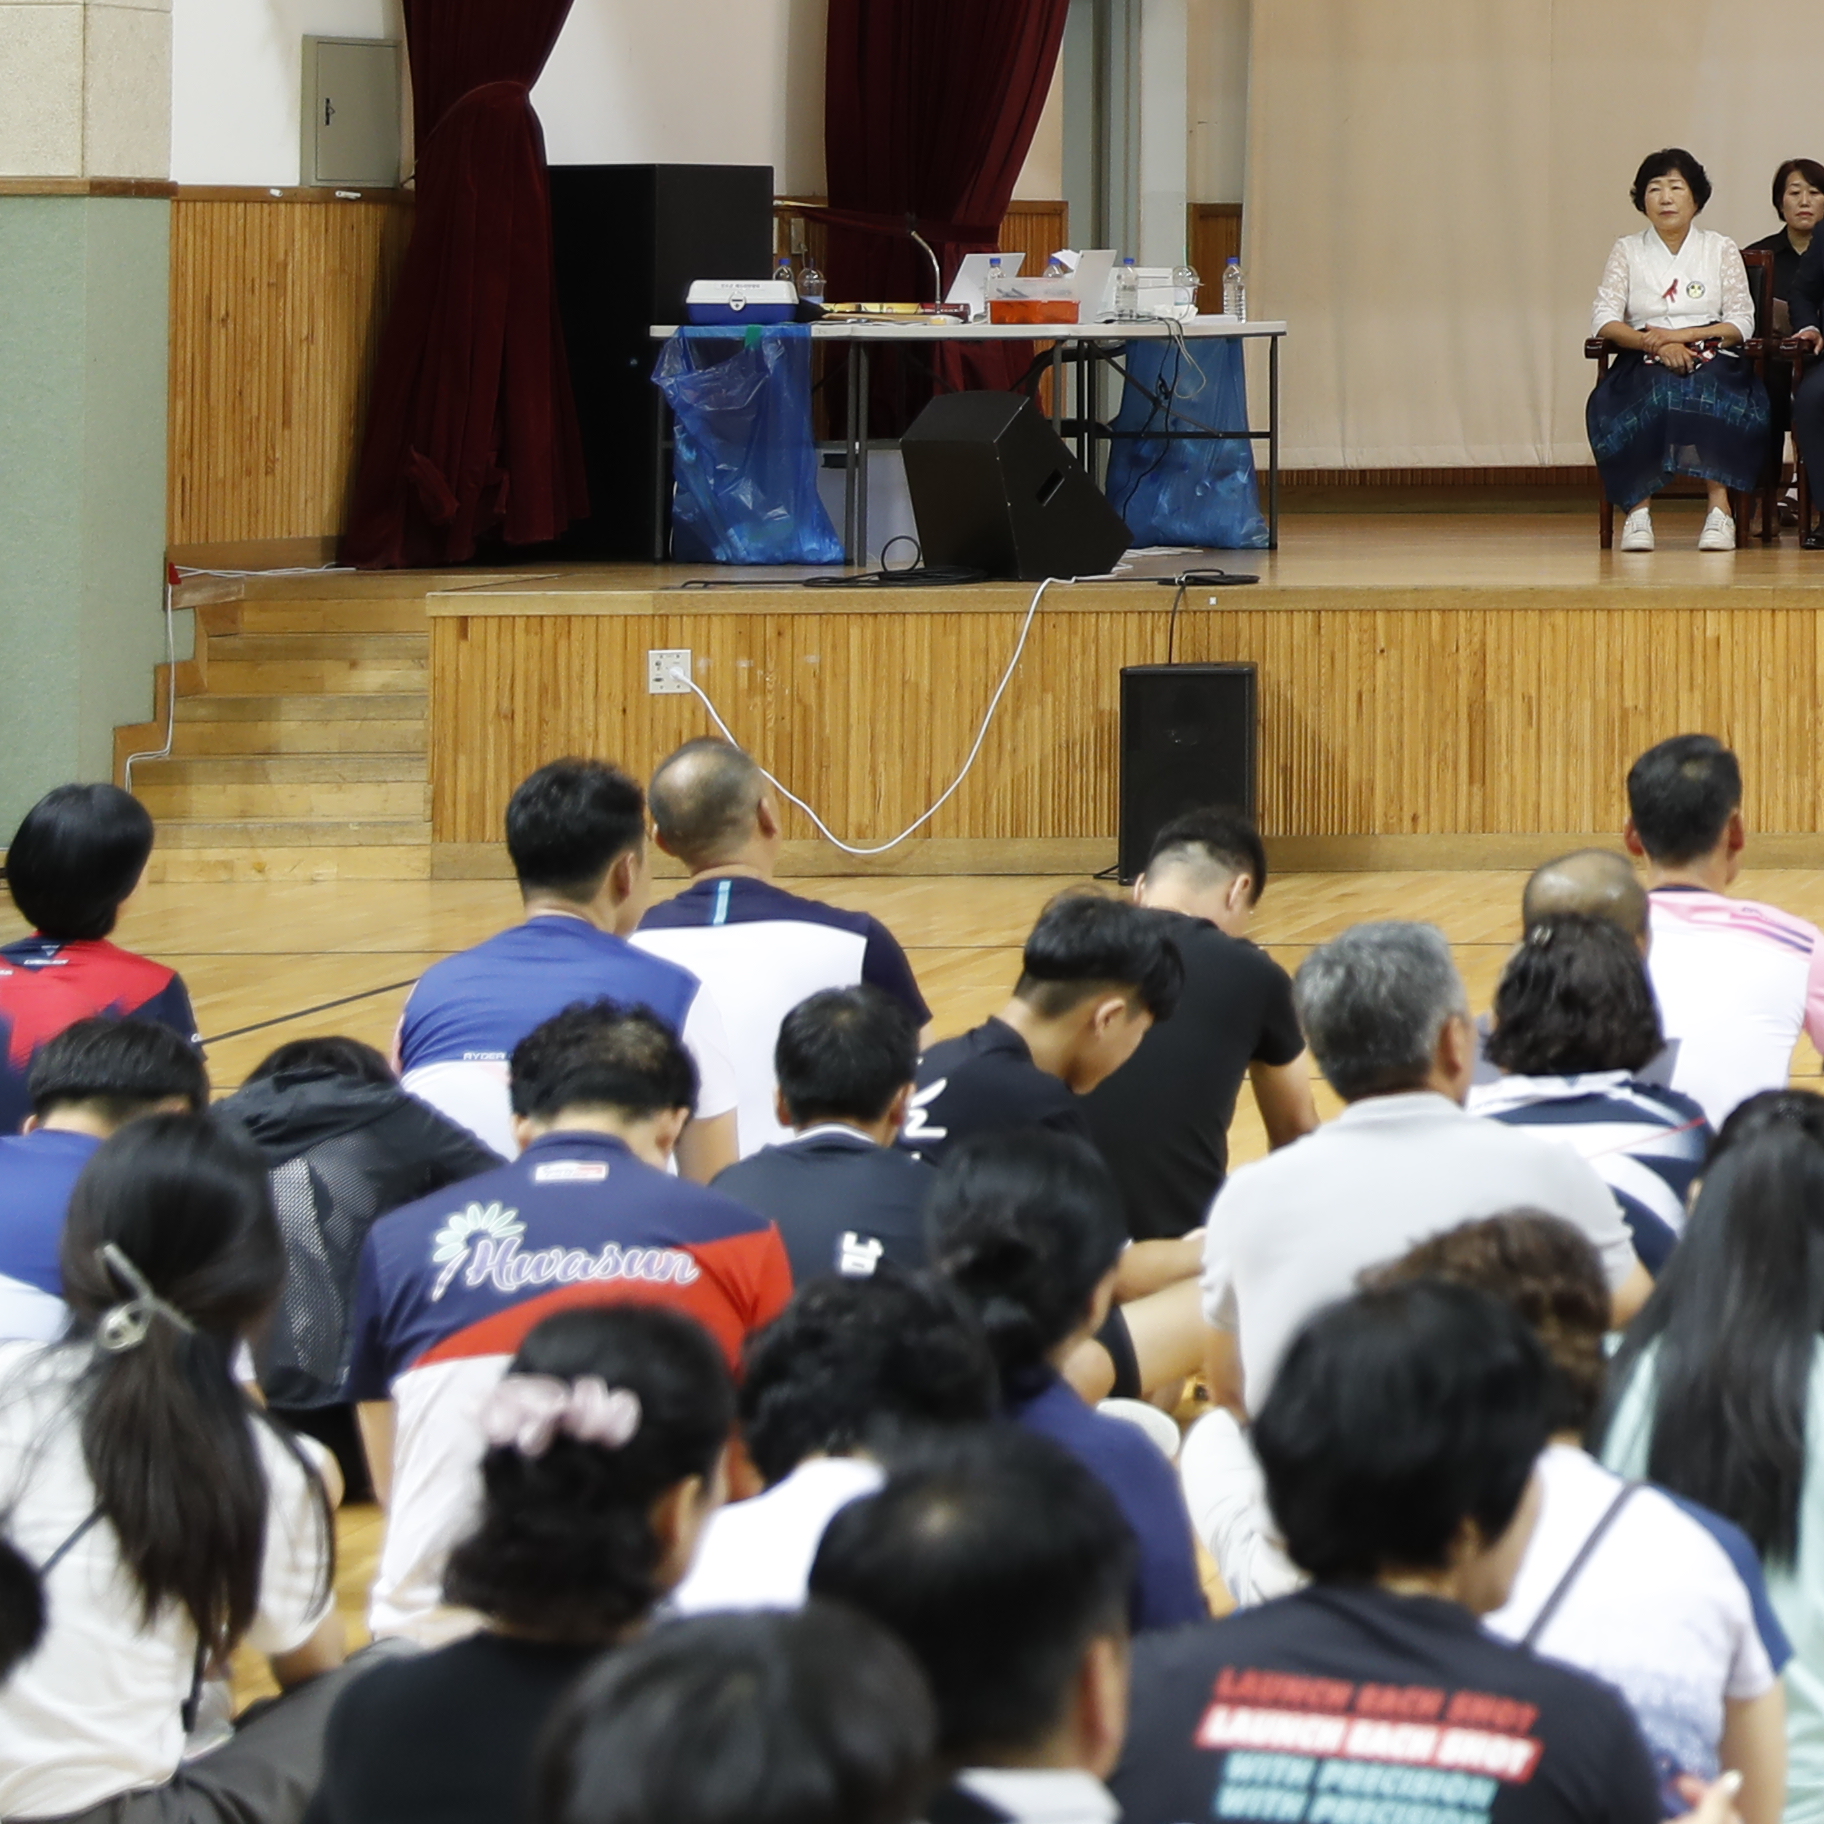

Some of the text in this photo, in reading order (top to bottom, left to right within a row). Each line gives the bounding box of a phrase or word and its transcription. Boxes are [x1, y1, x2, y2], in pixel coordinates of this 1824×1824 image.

[466, 1237, 700, 1291] Hwasun
[1205, 1704, 1348, 1755] LAUNCH
[1436, 1728, 1536, 1777] SHOT
[1224, 1751, 1498, 1809] WITH PRECISION
